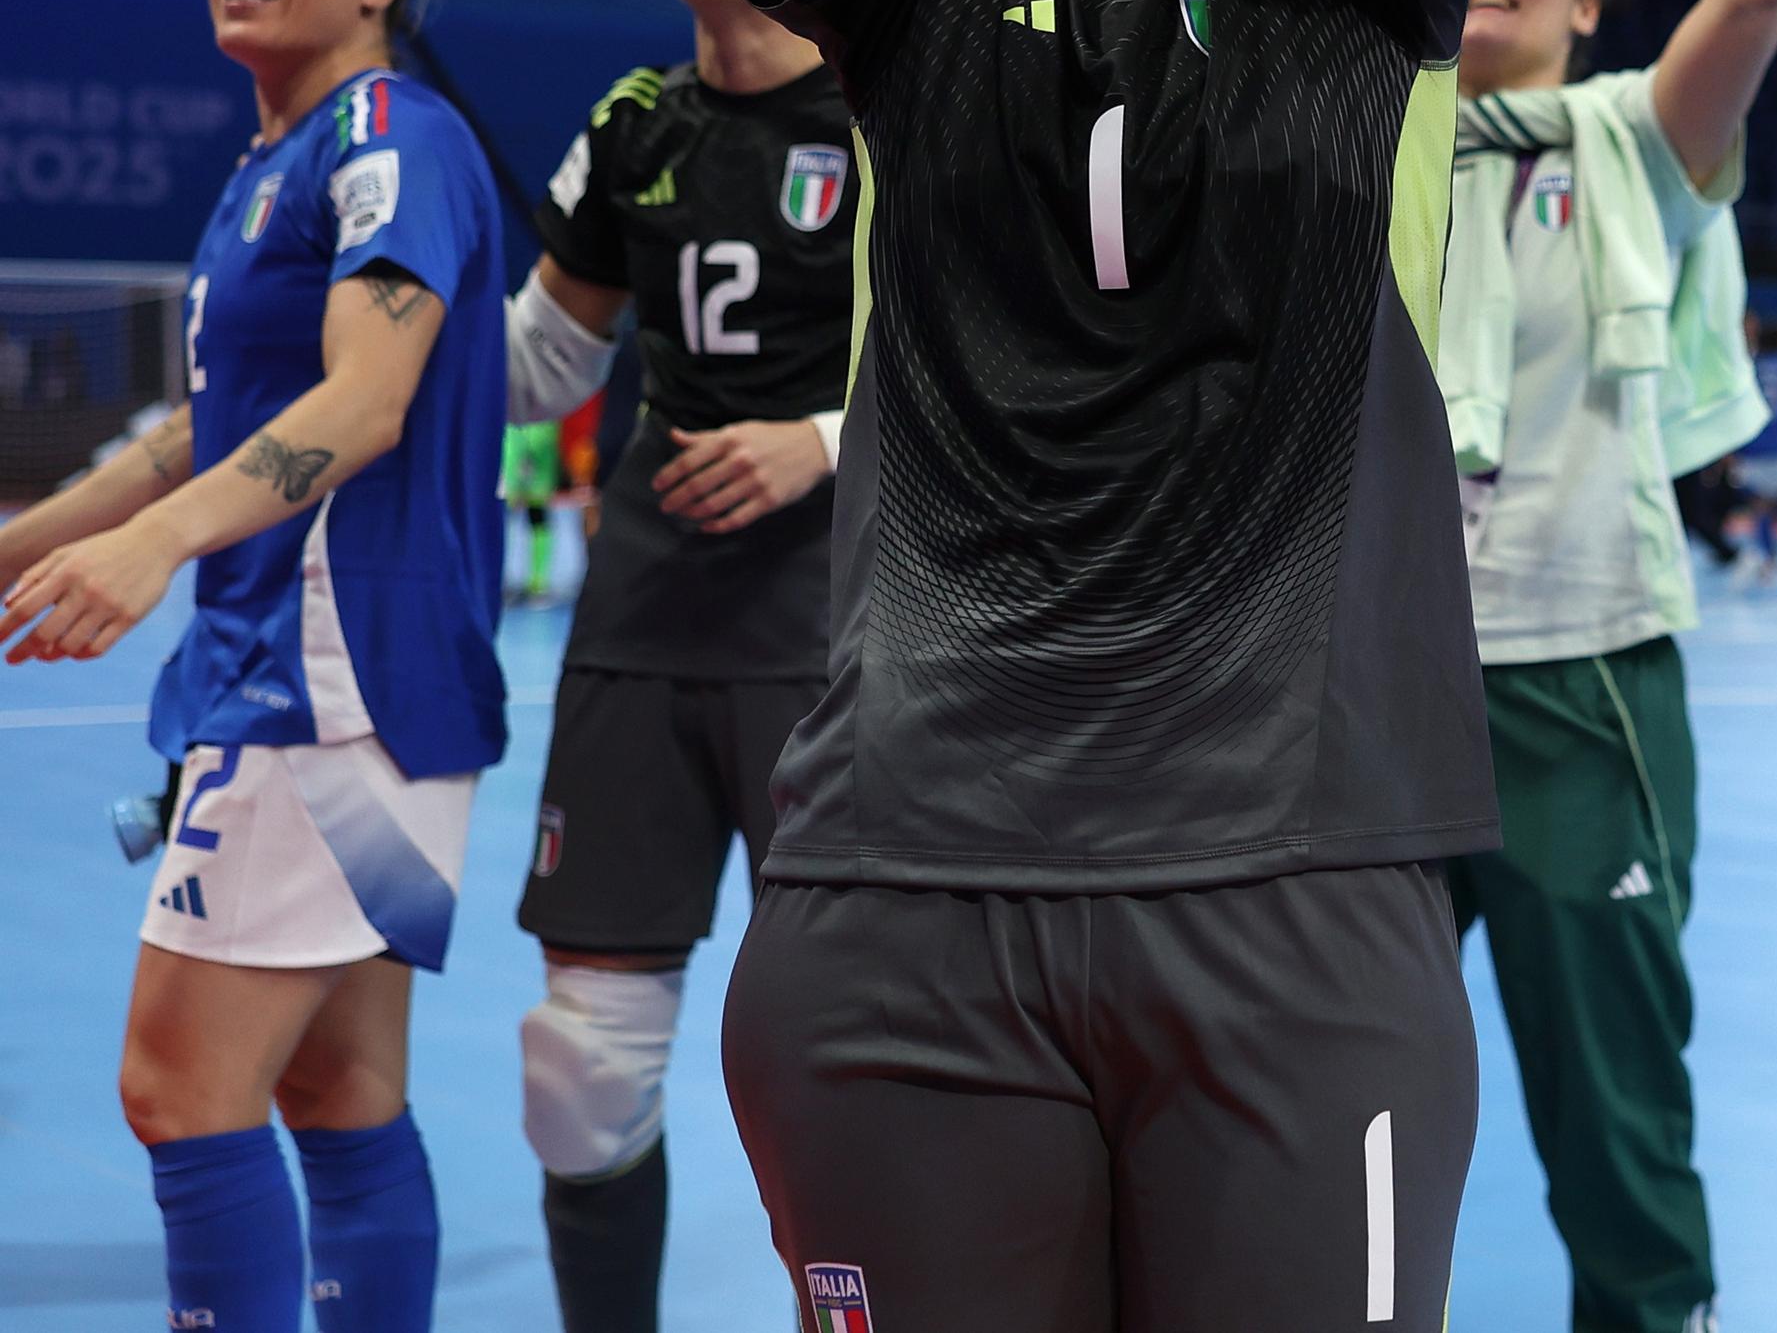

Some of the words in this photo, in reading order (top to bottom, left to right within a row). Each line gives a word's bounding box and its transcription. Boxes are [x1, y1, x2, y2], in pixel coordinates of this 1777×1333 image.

[1088, 104, 1130, 290] 1
[678, 240, 760, 355] 12
[810, 1273, 860, 1297] ITALIA
[1364, 1110, 1395, 1323] 1
